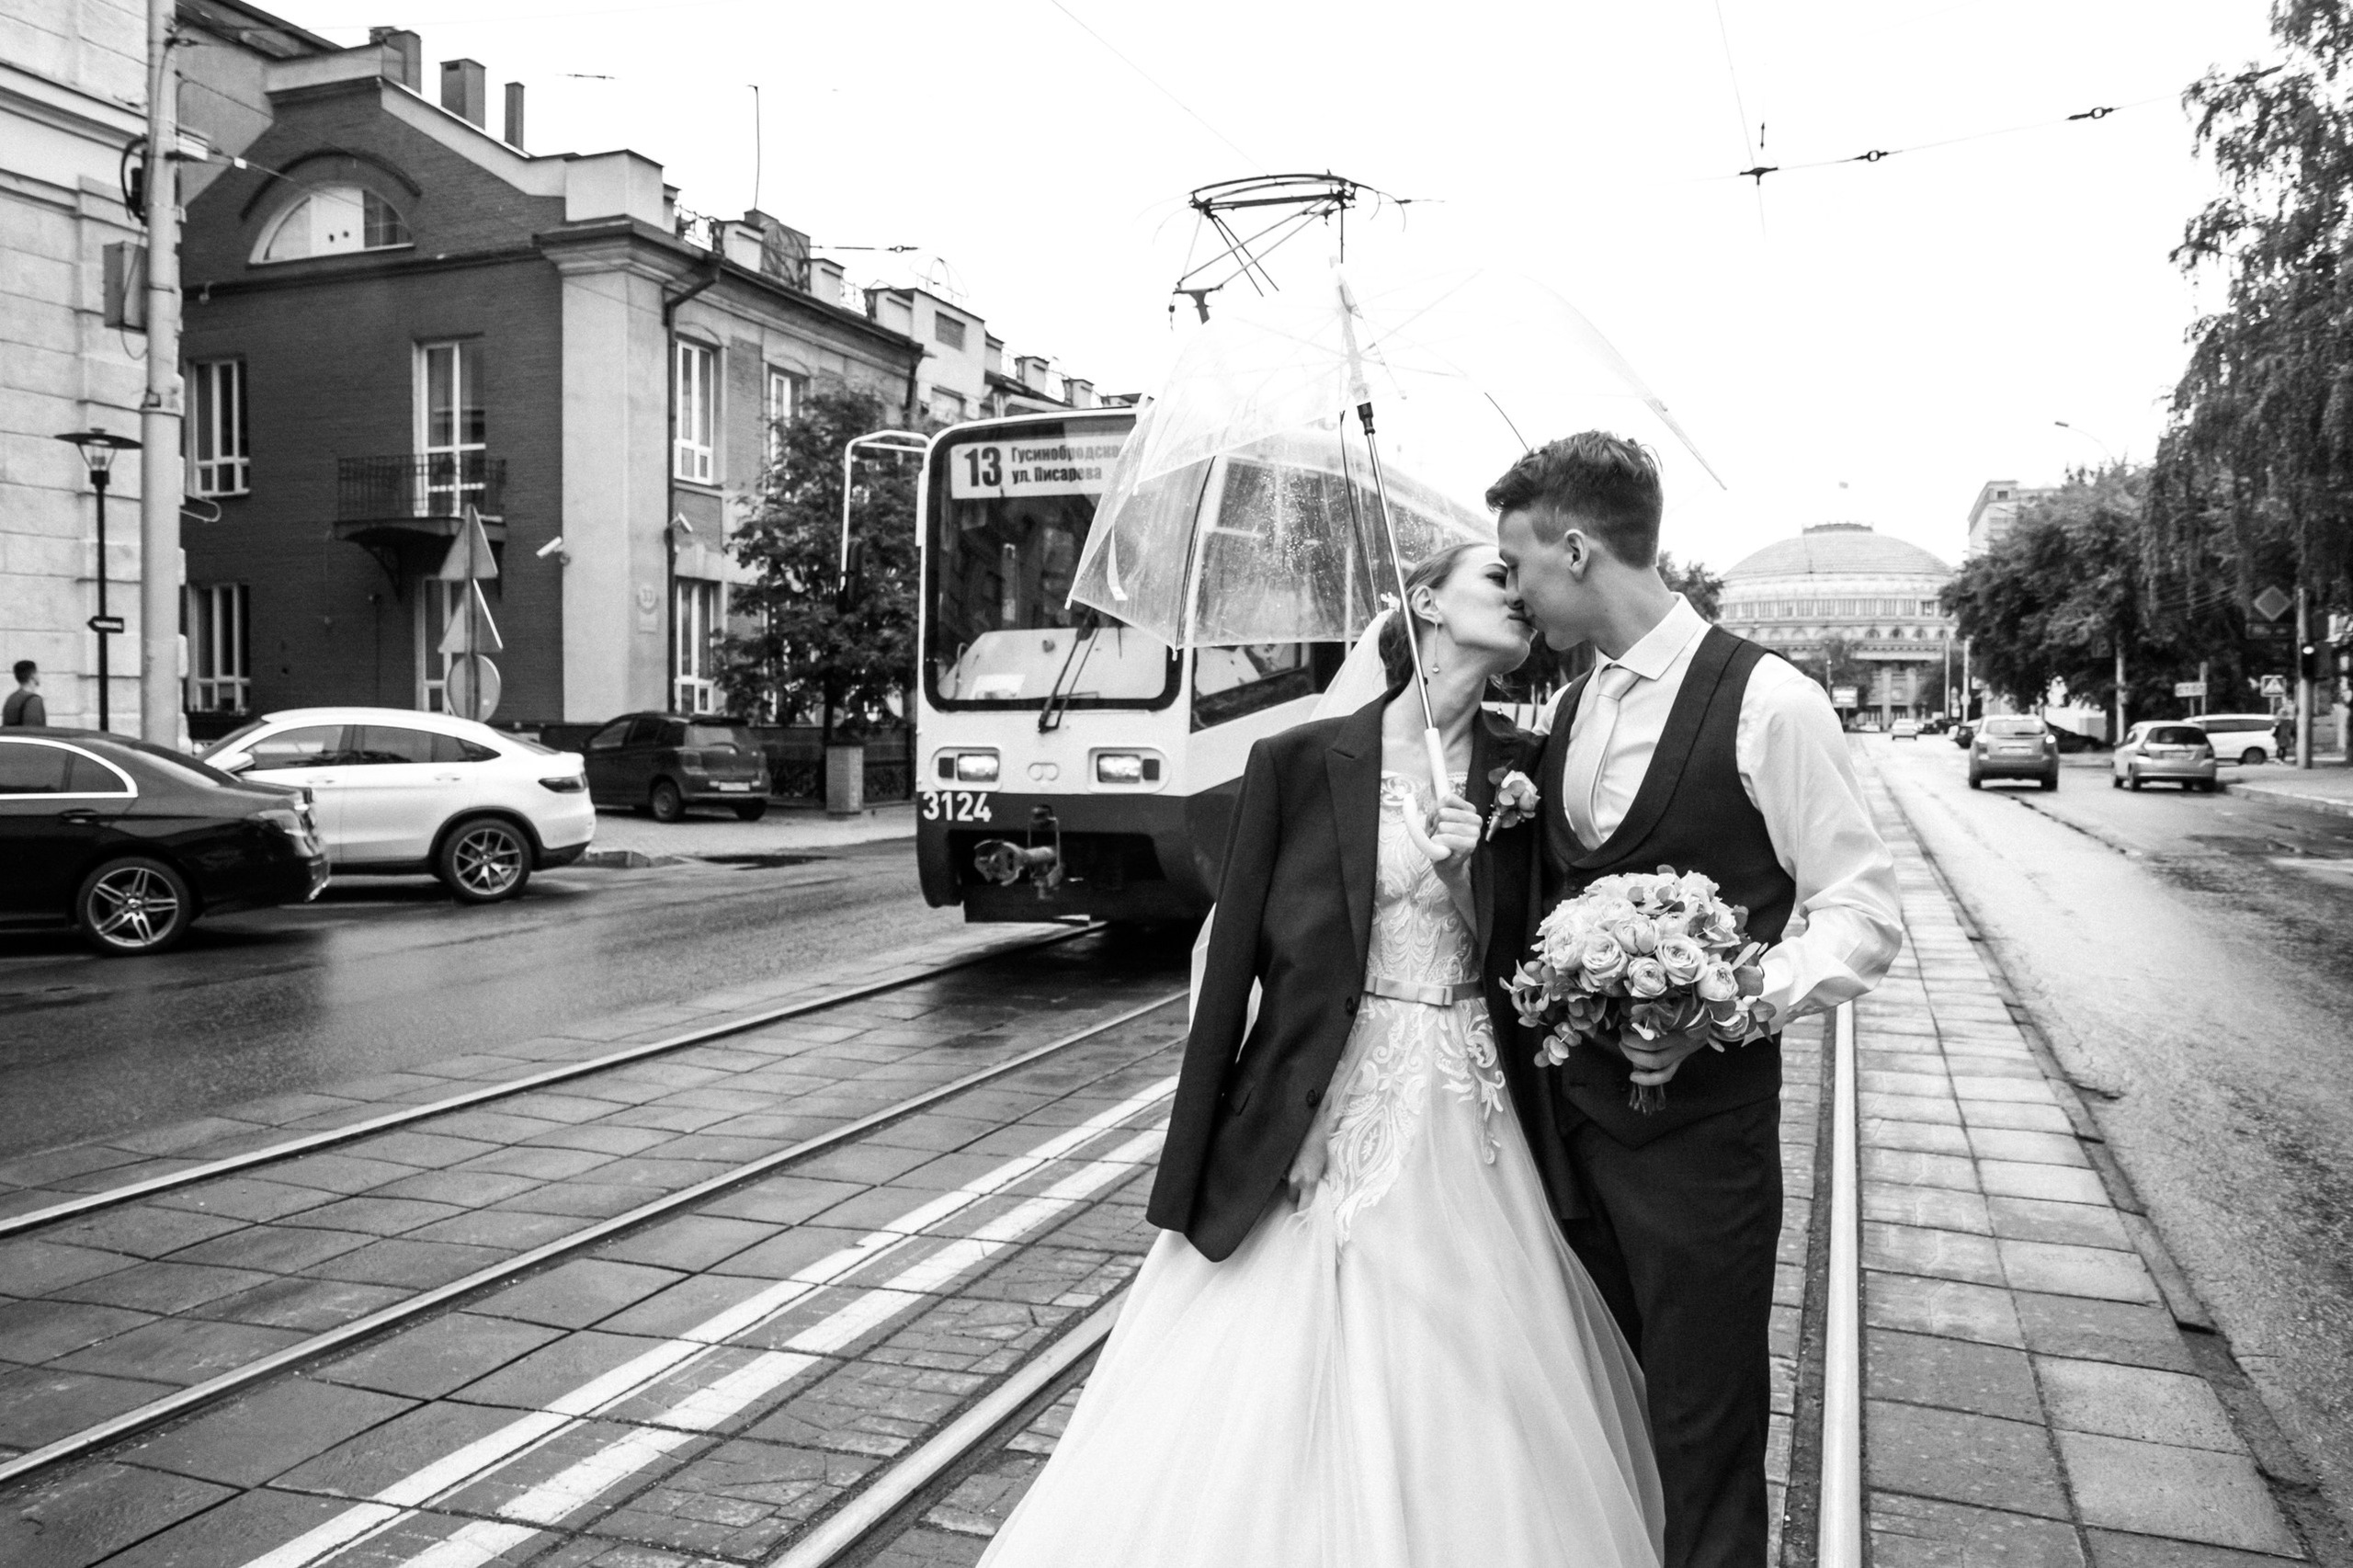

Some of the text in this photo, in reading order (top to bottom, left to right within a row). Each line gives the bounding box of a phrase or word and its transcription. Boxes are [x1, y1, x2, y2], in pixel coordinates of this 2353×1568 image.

[963, 446, 1003, 487] 13
[1012, 445, 1123, 463] Гусинобродско
[1012, 466, 1102, 484] ул. Писарева
[922, 791, 992, 823] 3124
